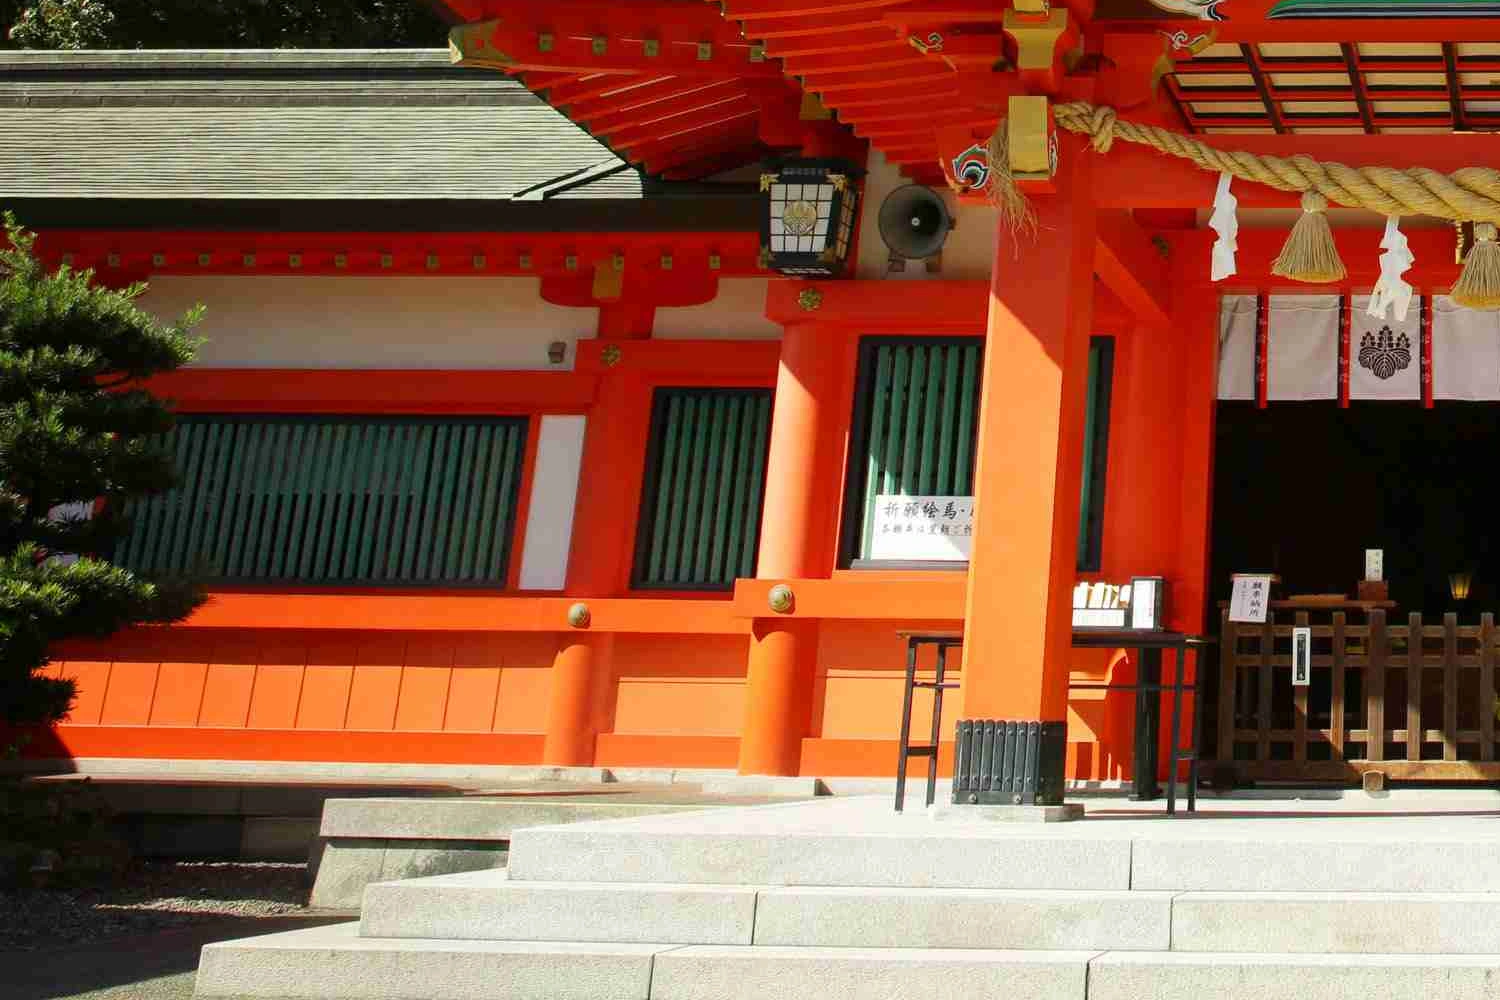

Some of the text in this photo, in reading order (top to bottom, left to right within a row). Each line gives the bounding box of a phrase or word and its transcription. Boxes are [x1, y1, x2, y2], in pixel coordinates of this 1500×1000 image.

[882, 502, 974, 519] 祈願絵馬・
